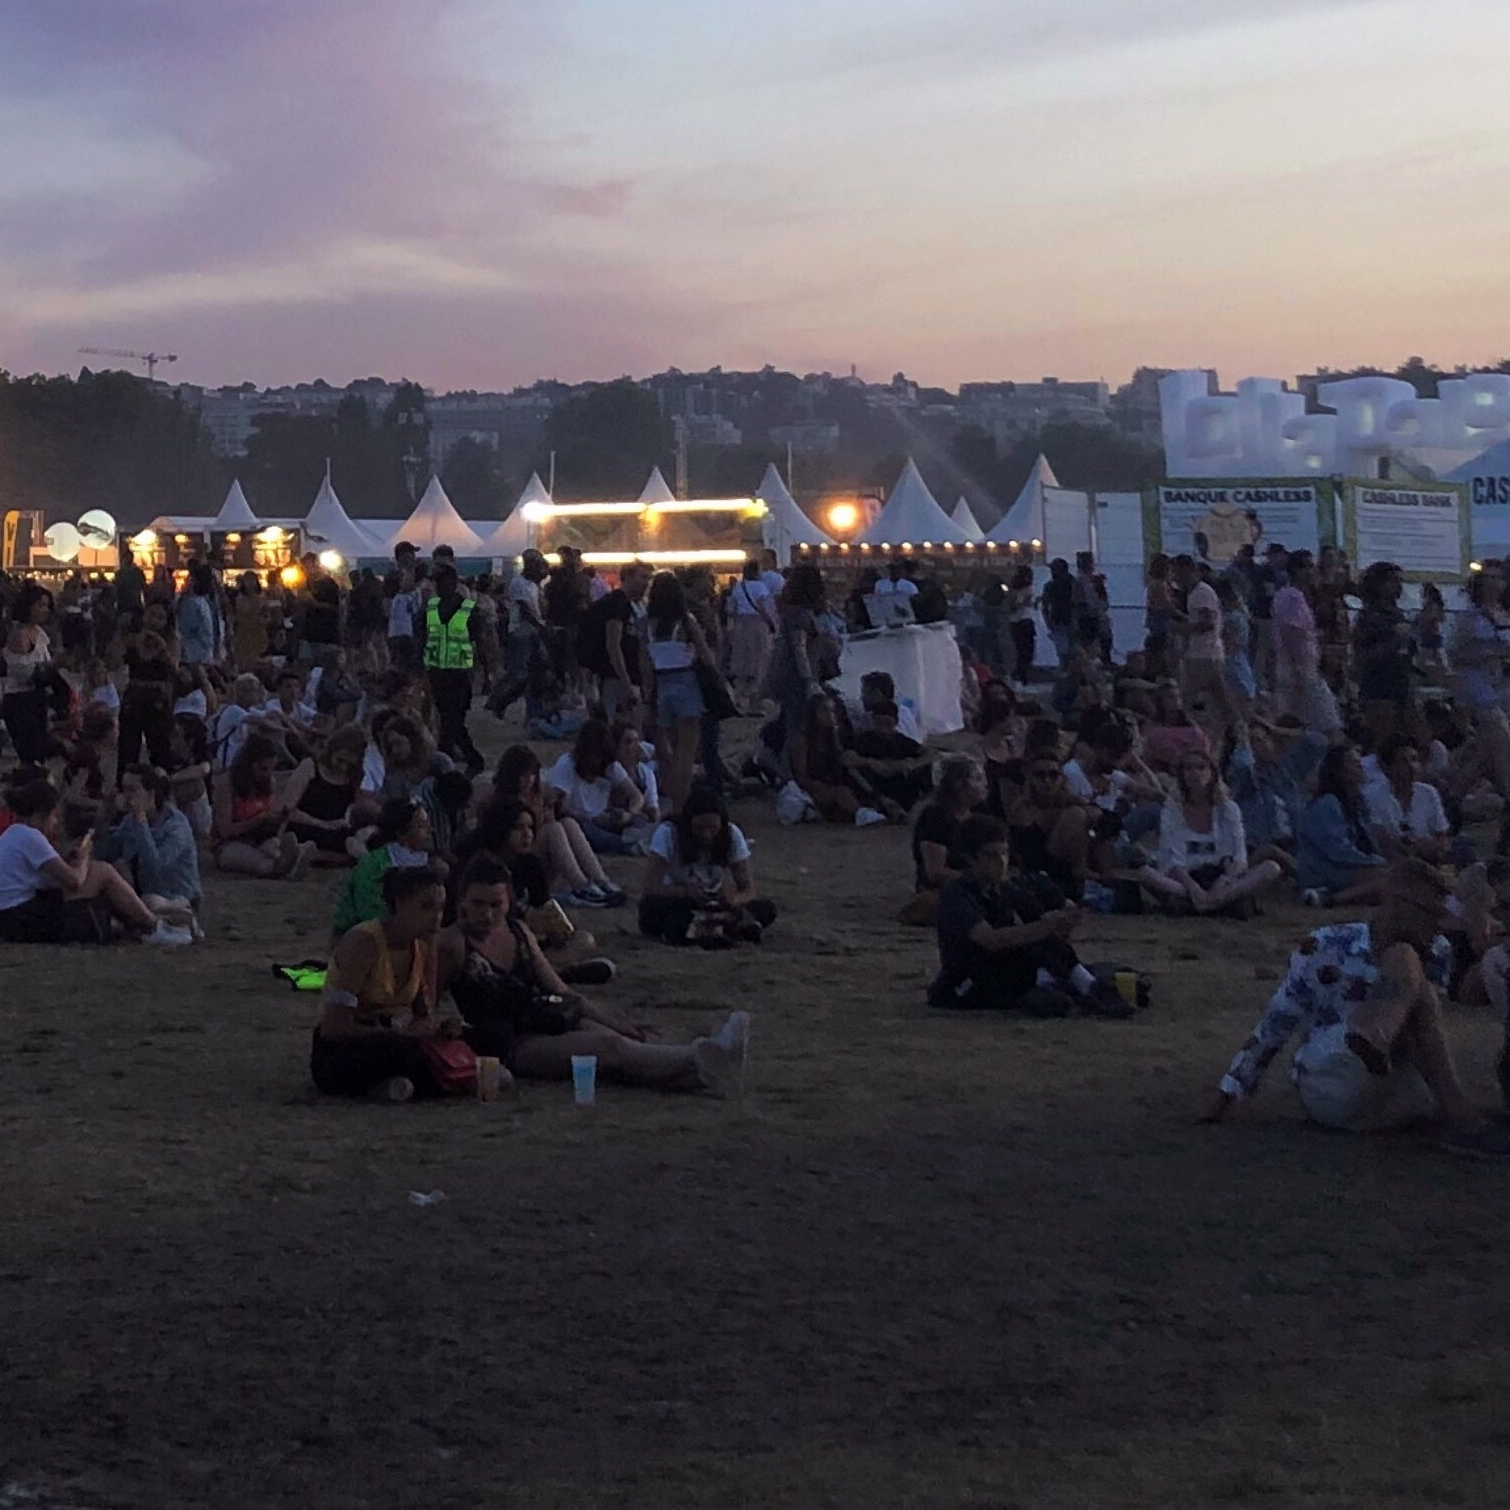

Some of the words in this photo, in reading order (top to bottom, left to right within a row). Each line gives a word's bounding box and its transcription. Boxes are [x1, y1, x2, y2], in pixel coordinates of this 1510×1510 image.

[1165, 490, 1228, 503] BANQUE
[1234, 490, 1312, 502] CASHLESS
[1362, 491, 1419, 506] CASHLESS
